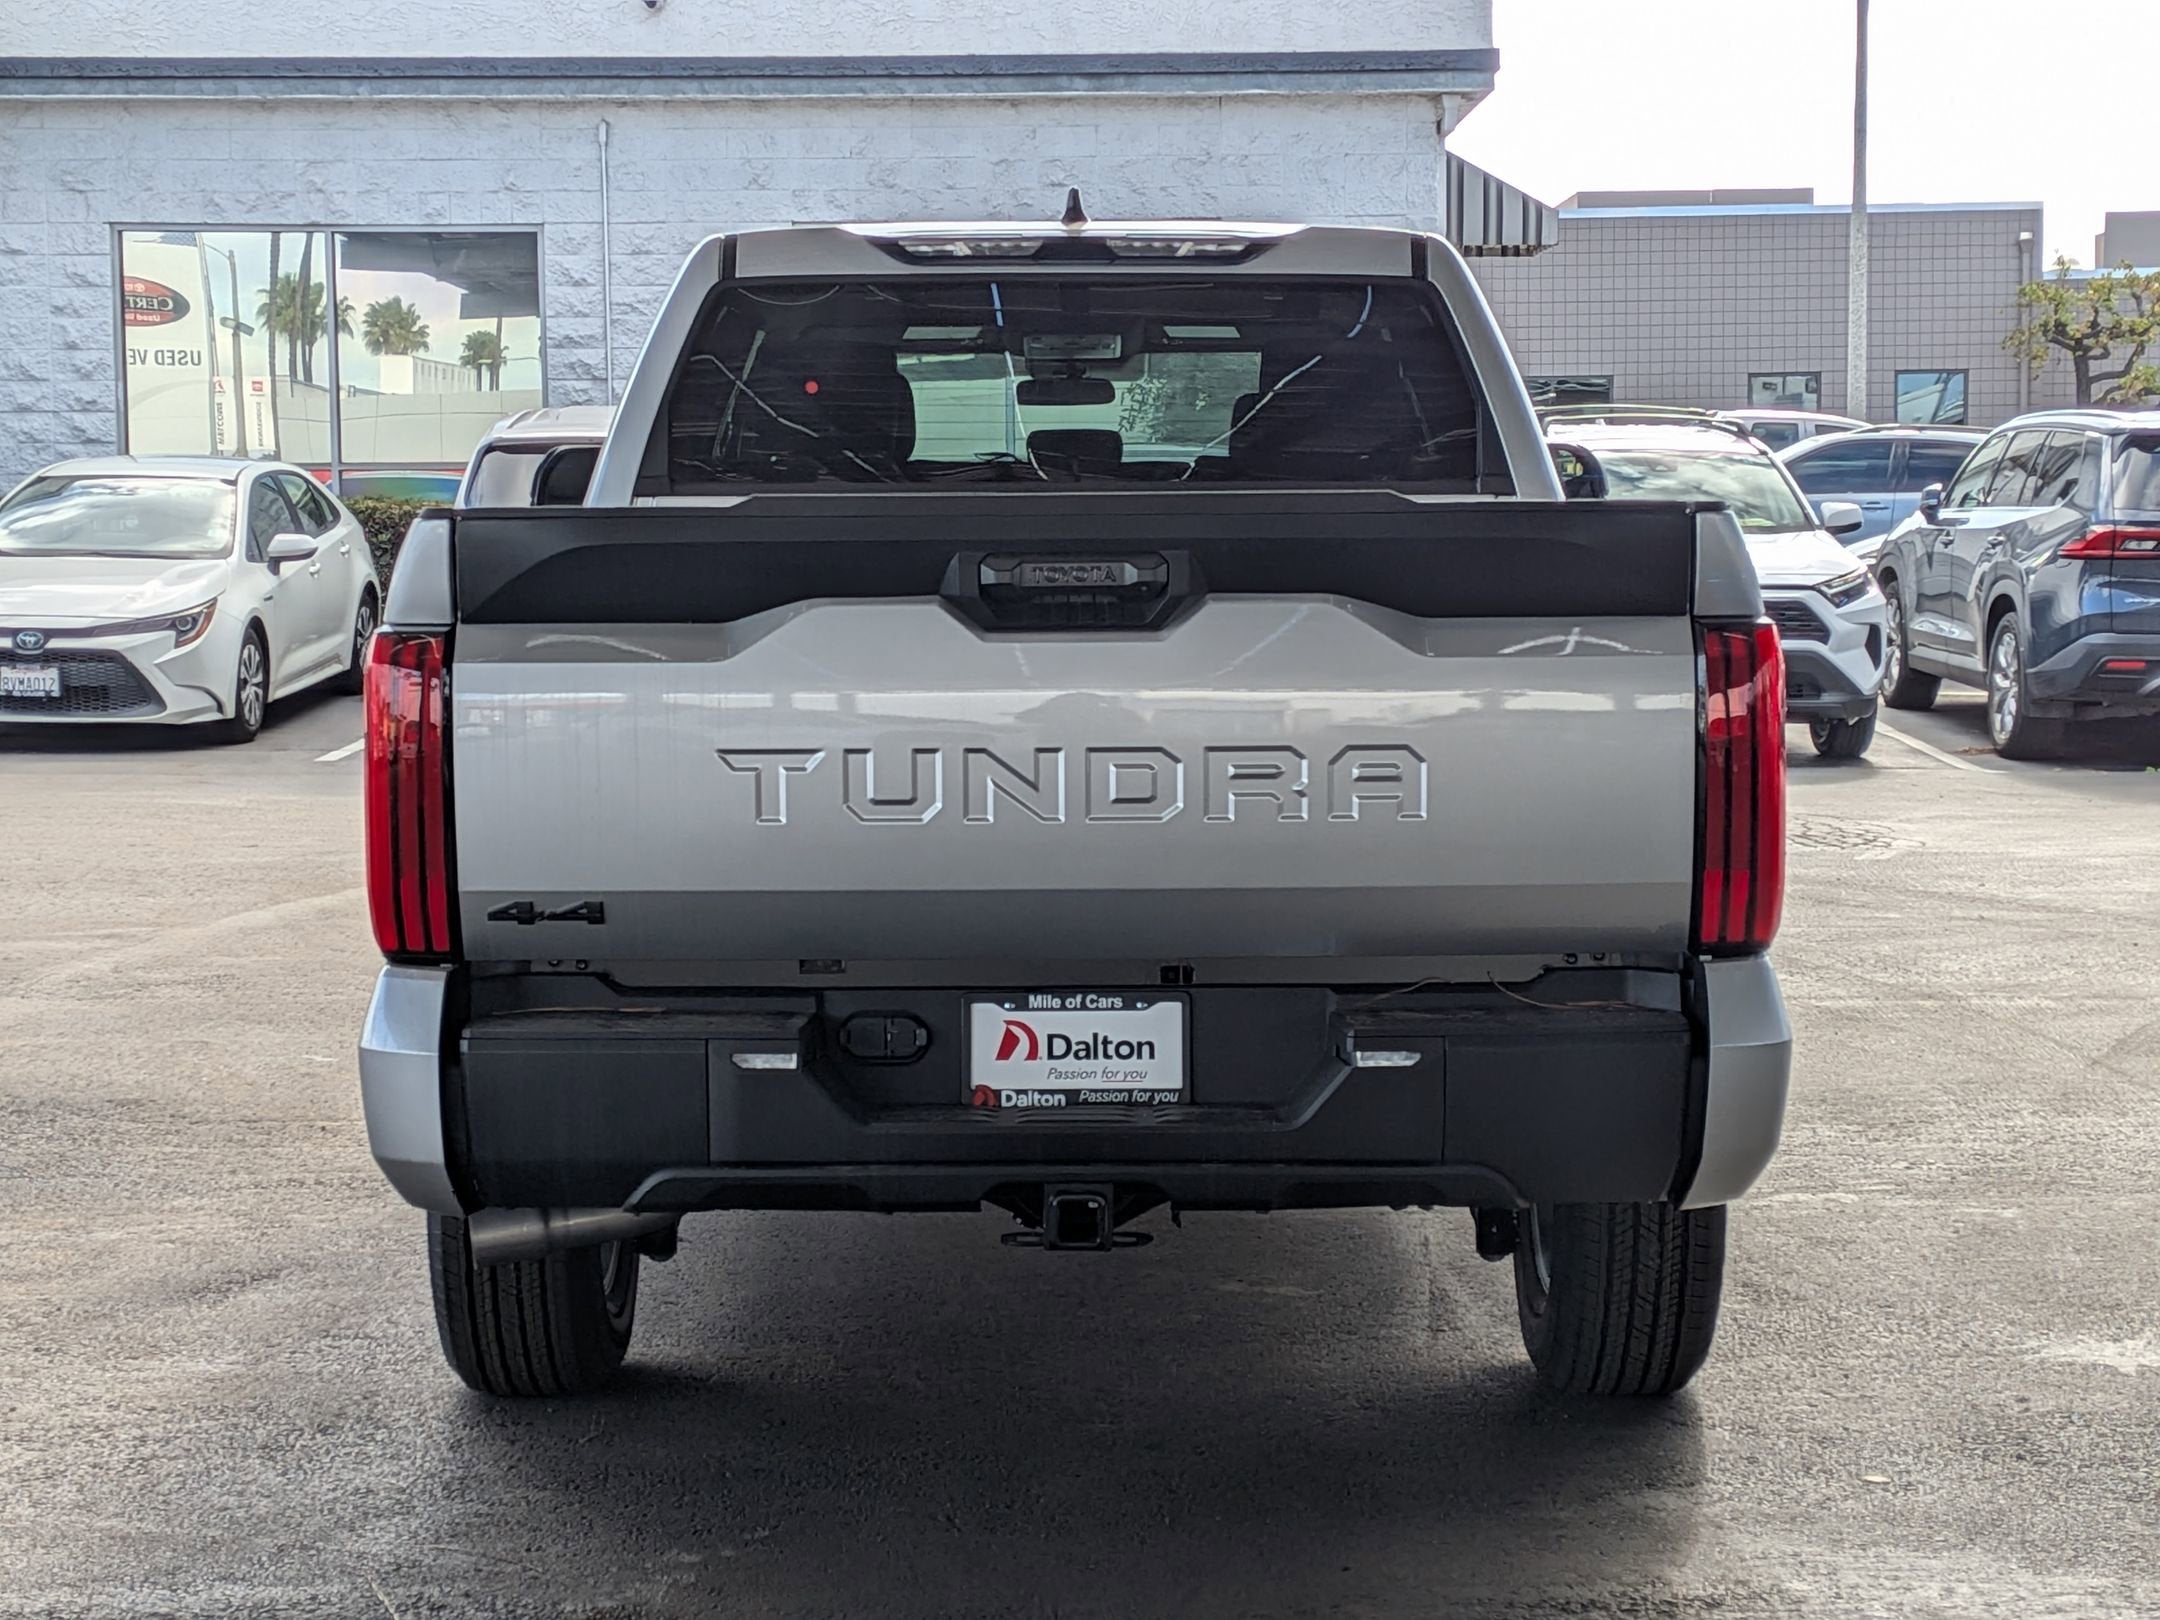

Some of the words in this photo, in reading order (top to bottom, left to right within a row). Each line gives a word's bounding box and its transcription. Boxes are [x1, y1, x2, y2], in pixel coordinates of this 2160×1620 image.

[1032, 565, 1117, 585] TOYOTA
[715, 747, 1429, 825] TUNDRA
[1028, 994, 1061, 1009] Mile
[1065, 994, 1083, 1009] of
[1085, 994, 1123, 1009] Cars
[1046, 1032, 1156, 1061] Dalton
[1046, 1067, 1097, 1080] Passion
[1101, 1066, 1119, 1080] for
[1123, 1070, 1148, 1081] you
[1001, 1090, 1067, 1108] Dalton
[1079, 1090, 1129, 1103] Passion
[1131, 1089, 1151, 1103] for
[1152, 1091, 1179, 1106] you
